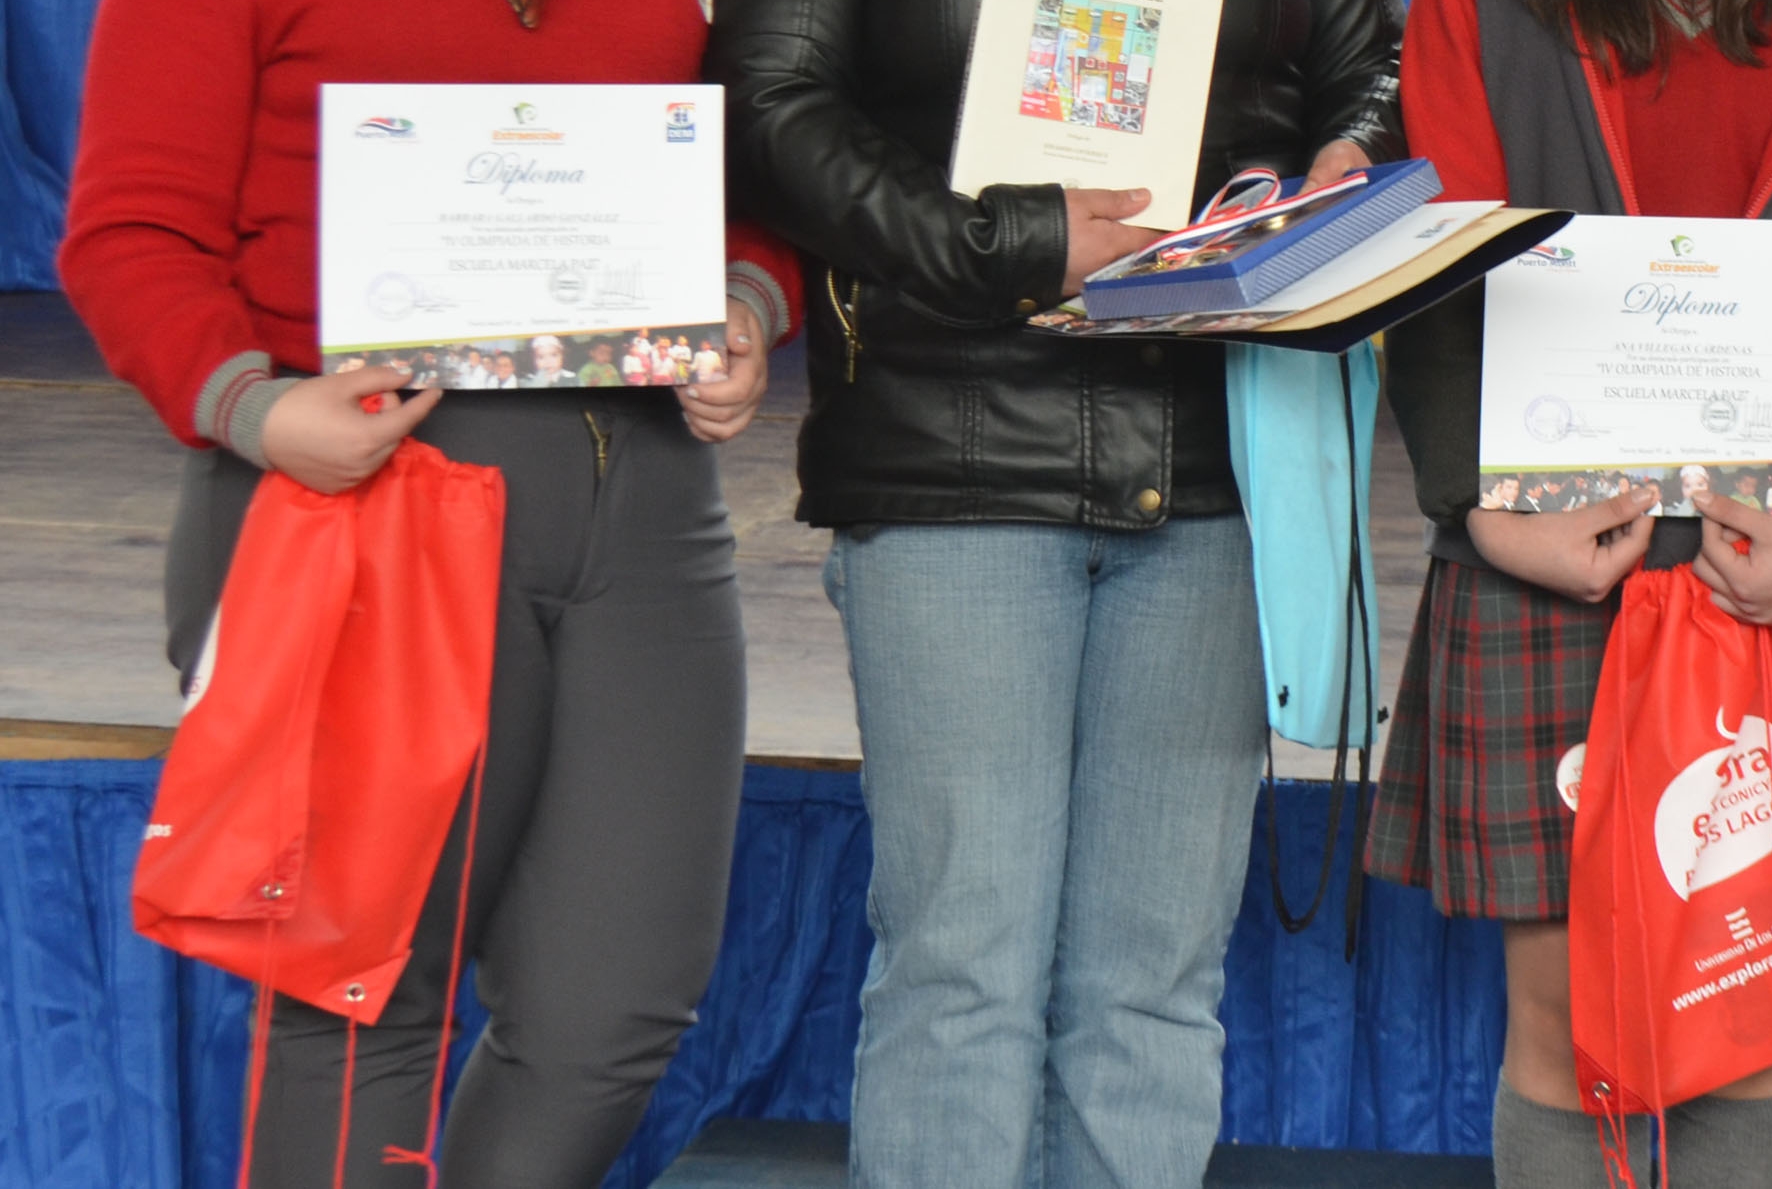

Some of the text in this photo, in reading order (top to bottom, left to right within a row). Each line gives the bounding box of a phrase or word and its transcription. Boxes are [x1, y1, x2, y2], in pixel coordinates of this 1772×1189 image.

[462, 151, 587, 195] Diploma
[1620, 281, 1742, 326] Diploma
[1615, 362, 1683, 376] OLIMPIADA
[1685, 364, 1704, 377] DE
[1705, 365, 1762, 379] HISTORIA
[1603, 386, 1658, 400] ESCUELA
[1660, 388, 1719, 402] MARCELA
